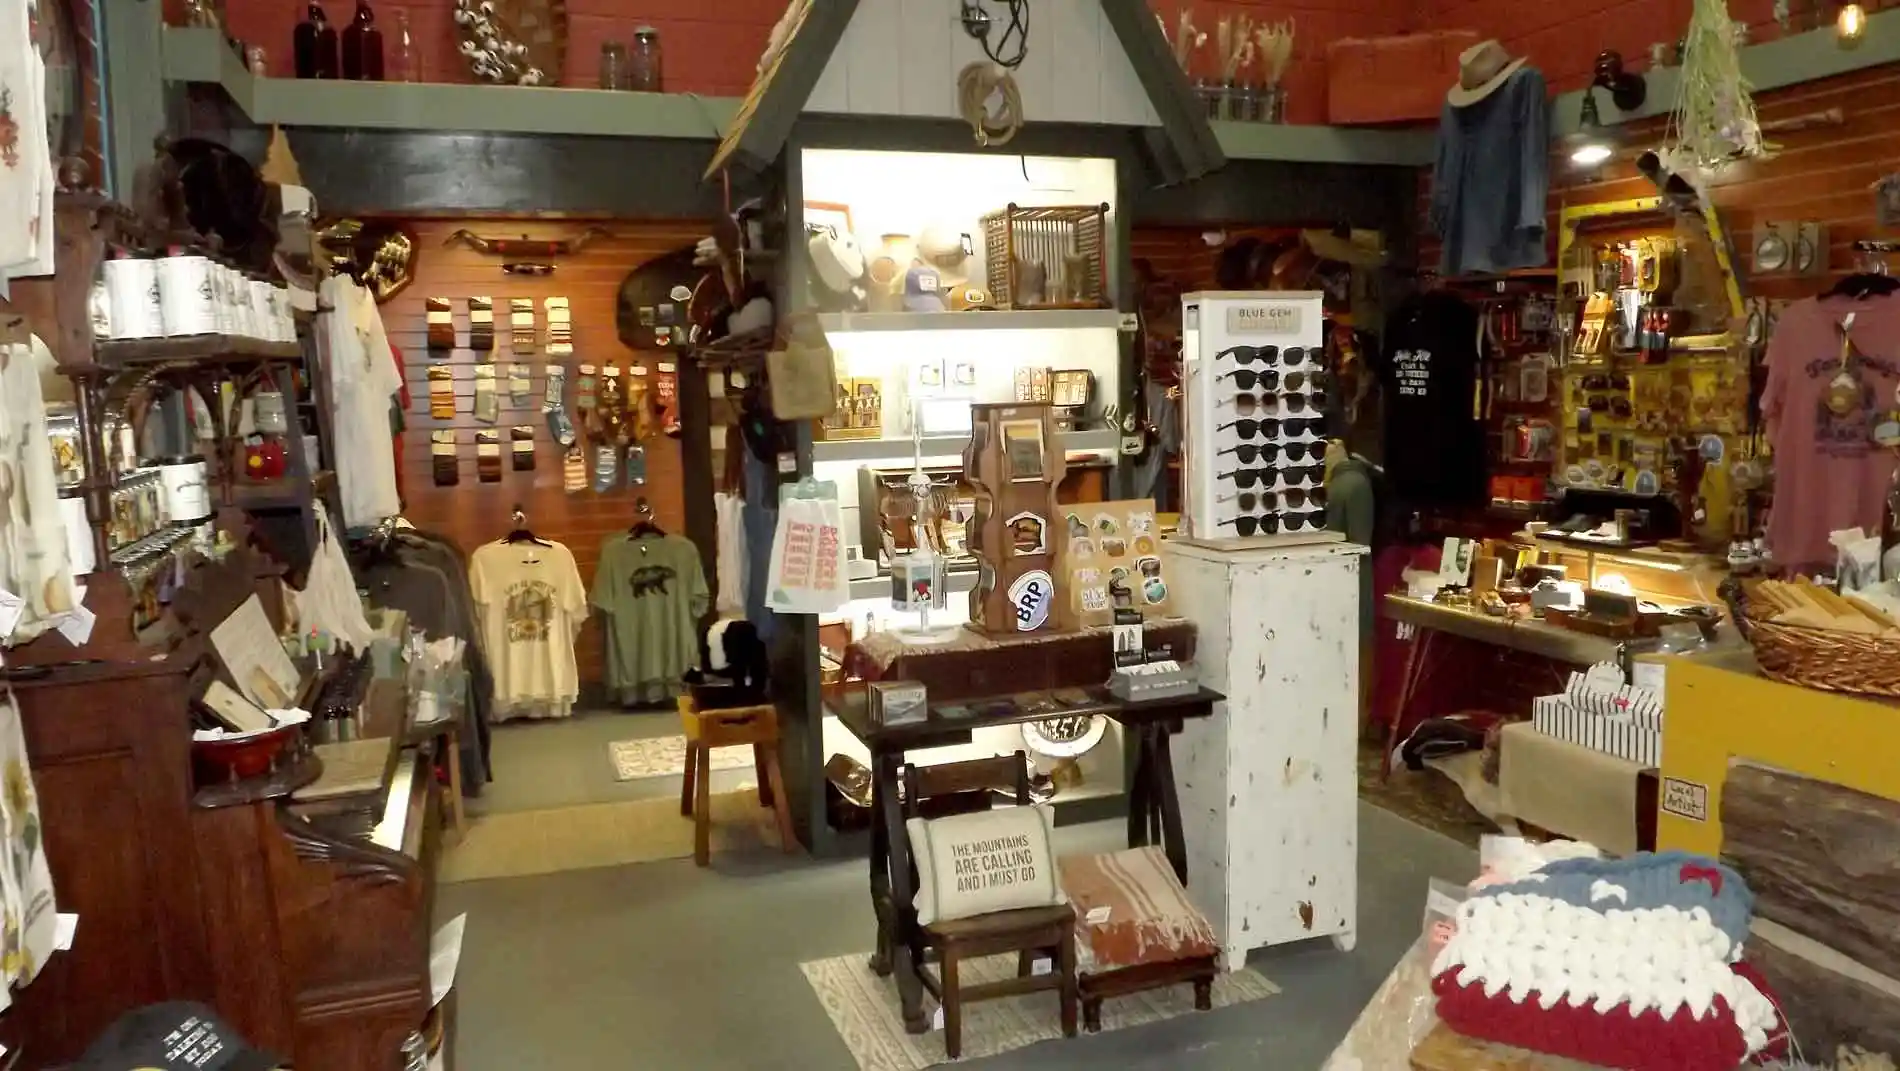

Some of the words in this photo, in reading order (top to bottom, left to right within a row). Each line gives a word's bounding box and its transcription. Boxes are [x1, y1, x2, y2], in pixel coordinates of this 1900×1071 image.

[1239, 308, 1265, 318] BLUE
[1269, 308, 1292, 318] GEM
[1016, 582, 1042, 622] BRP
[951, 844, 971, 857] THE
[972, 834, 1029, 854] MOUNTAINS
[955, 858, 979, 875] ARE
[982, 849, 1033, 871] CALLING
[957, 876, 980, 893] AND
[989, 868, 1018, 888] MUST
[1021, 866, 1036, 881] GO
